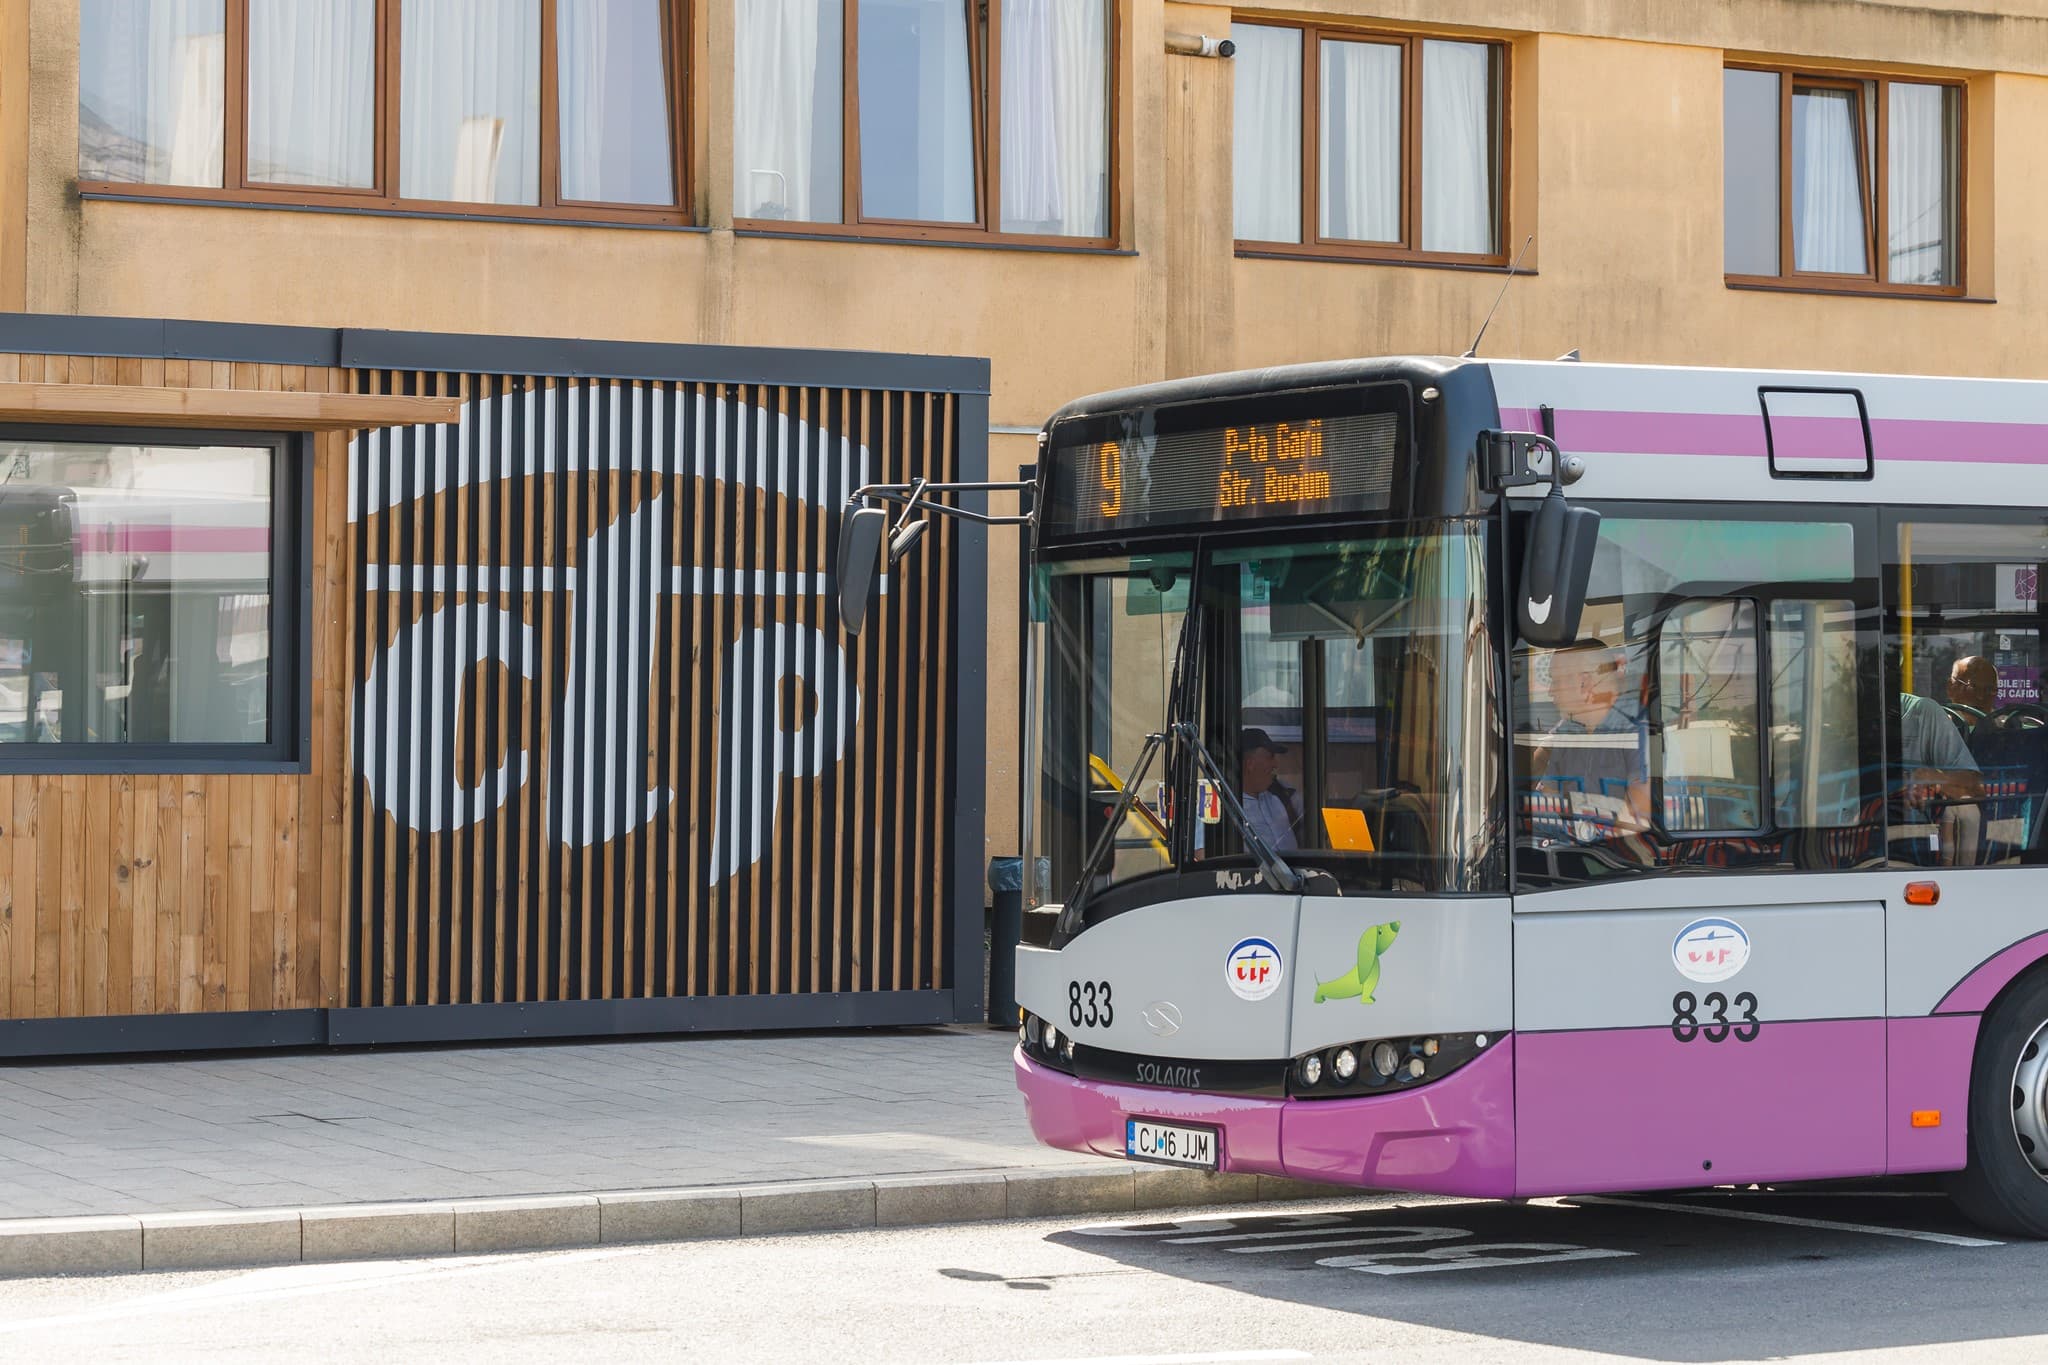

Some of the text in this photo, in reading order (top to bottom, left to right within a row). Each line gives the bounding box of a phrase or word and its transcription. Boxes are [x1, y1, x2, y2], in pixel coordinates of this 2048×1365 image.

[1225, 418, 1322, 465] P-ta Garii
[1100, 442, 1121, 517] 9
[1219, 466, 1329, 507] Str. Bucium
[1997, 679, 2031, 688] BILETE
[1069, 980, 1114, 1028] 833
[1672, 991, 1760, 1043] 833
[1136, 1063, 1201, 1089] SOLARIS
[1139, 1127, 1208, 1162] CJ 16 JJM
[1068, 1212, 1639, 1275] BUS
